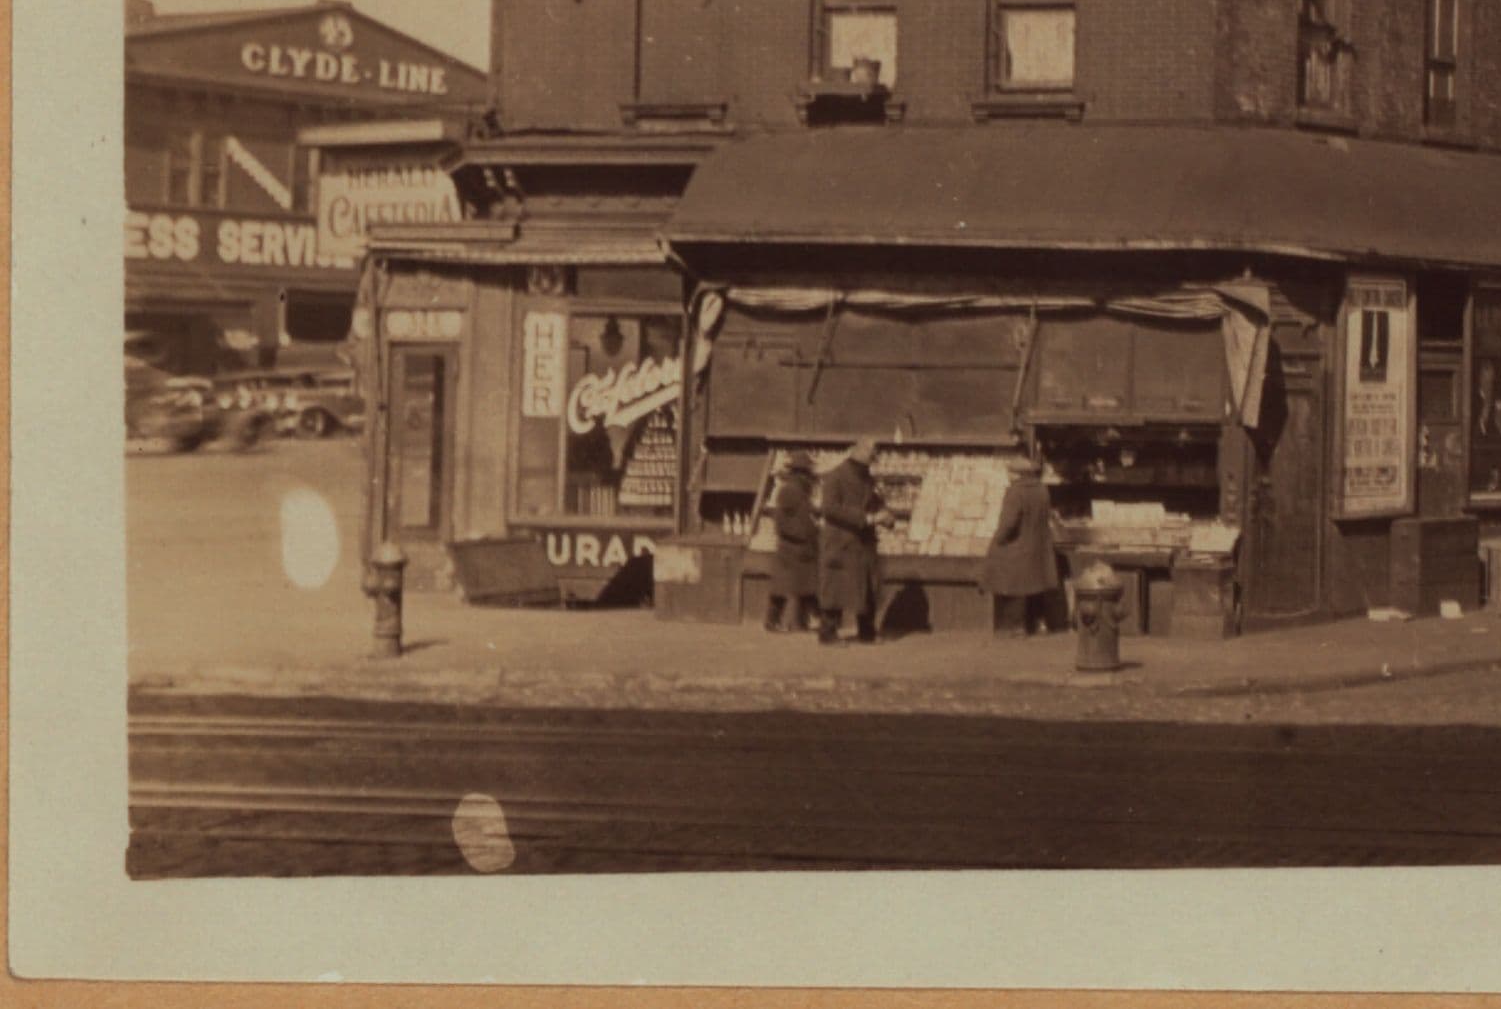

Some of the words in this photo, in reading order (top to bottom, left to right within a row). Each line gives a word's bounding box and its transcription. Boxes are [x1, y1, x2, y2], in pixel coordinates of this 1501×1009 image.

[241, 42, 361, 84] CLYDE
[379, 58, 448, 96] LINE
[217, 219, 355, 269] SERVI
